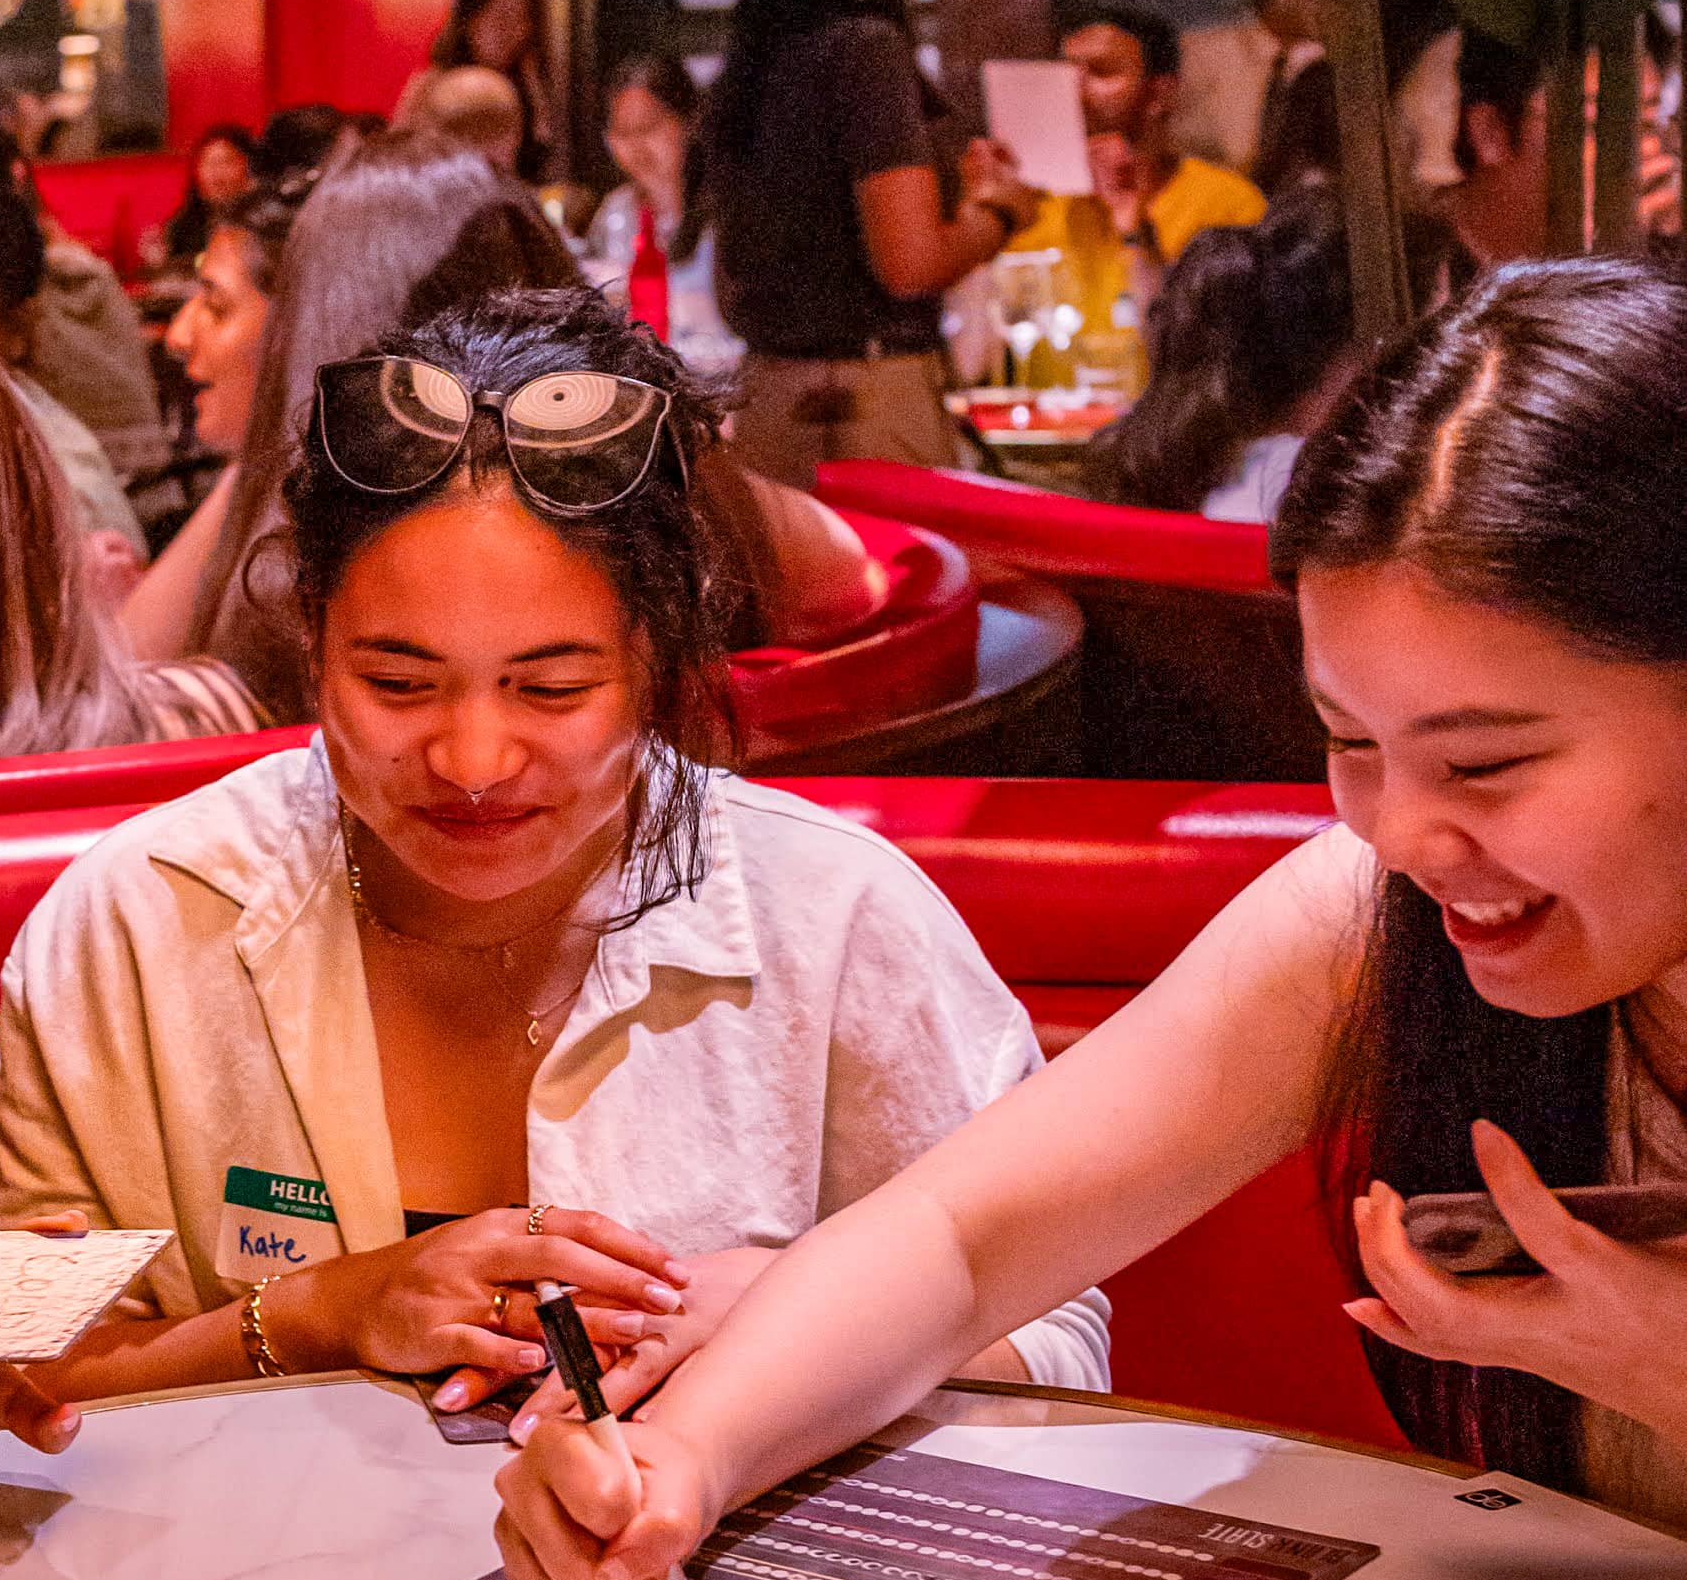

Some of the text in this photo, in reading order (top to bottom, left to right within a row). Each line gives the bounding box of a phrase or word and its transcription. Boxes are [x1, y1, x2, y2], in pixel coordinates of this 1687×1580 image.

[274, 1201, 328, 1218] my name is
[239, 1225, 307, 1263] Kate
[1197, 1522, 1275, 1549] SLATE
